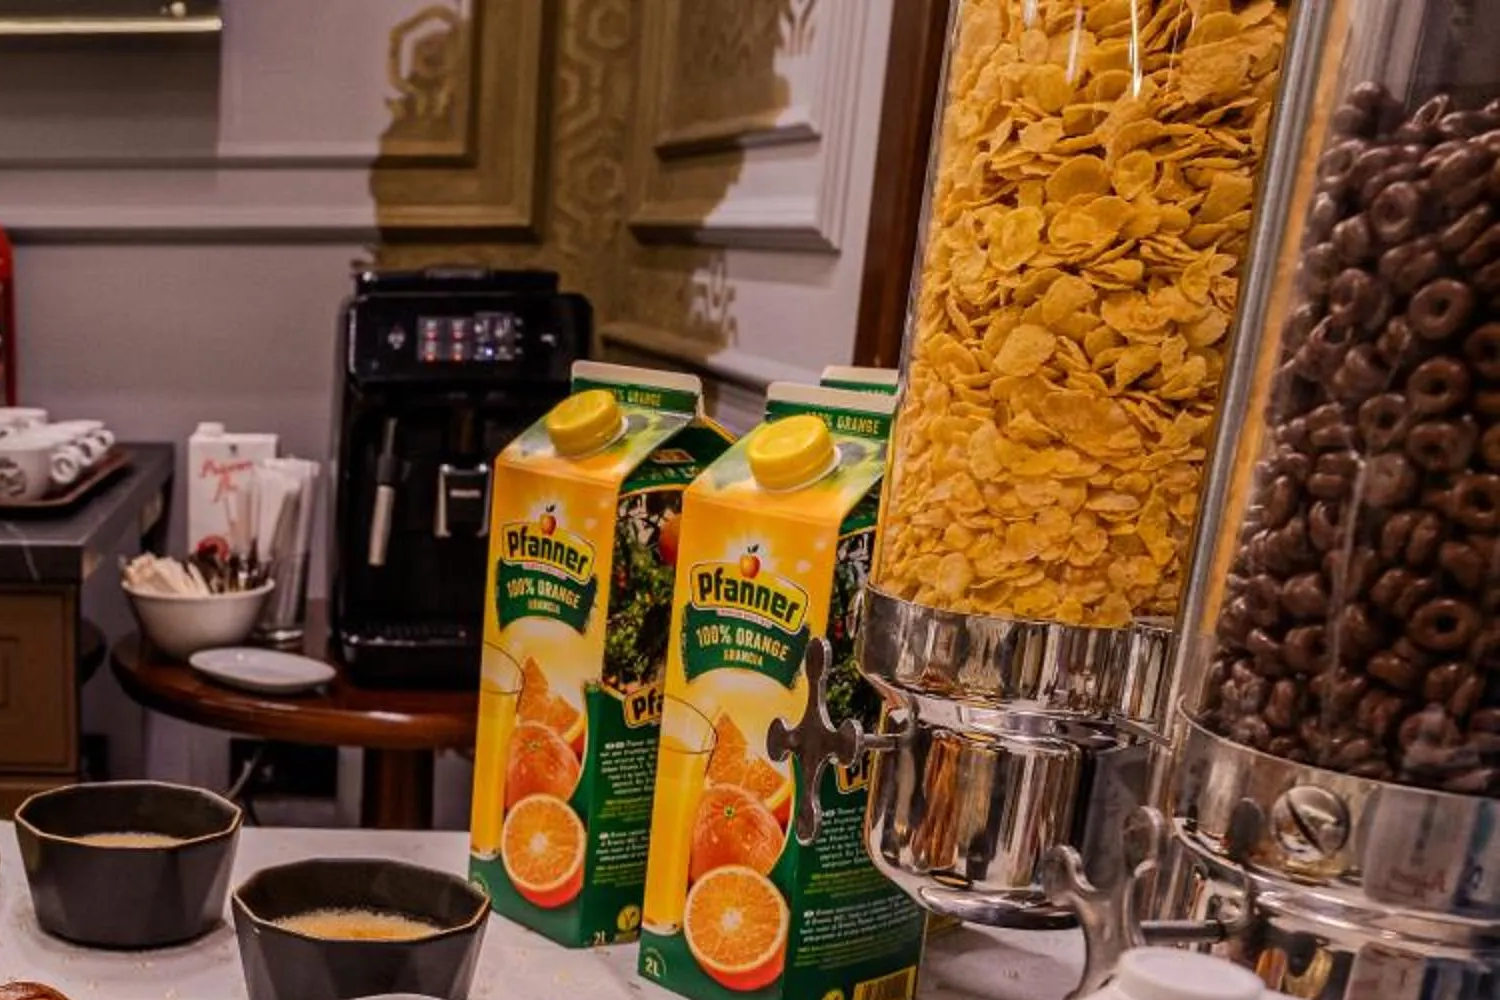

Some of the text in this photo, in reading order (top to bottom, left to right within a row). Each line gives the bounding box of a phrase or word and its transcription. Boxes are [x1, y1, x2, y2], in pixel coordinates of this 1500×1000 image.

[837, 415, 880, 434] ORANGE
[507, 578, 535, 599] 100%
[537, 579, 581, 609] ORANGE
[696, 624, 790, 661] 100% ORANGE
[645, 955, 661, 977] 2L
